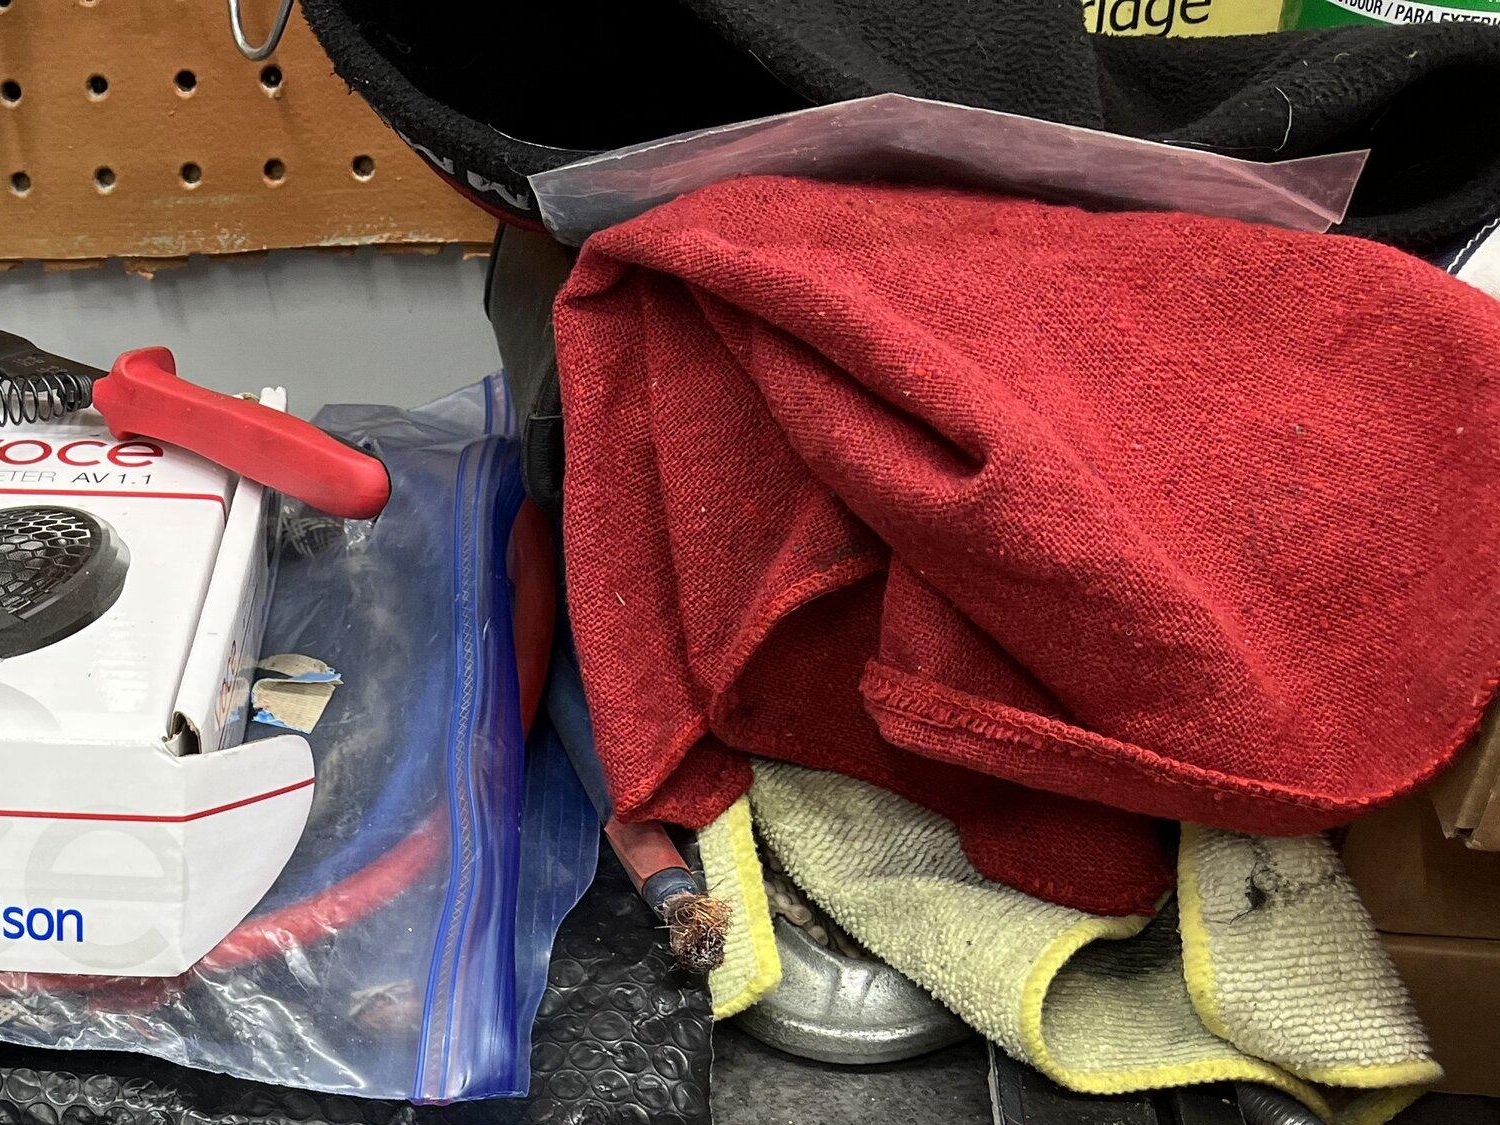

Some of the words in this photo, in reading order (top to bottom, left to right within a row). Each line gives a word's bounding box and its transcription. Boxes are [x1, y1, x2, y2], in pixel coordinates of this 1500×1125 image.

[1395, 4, 1434, 23] PARA
[72, 472, 110, 484] AV
[120, 473, 152, 485] 1.1
